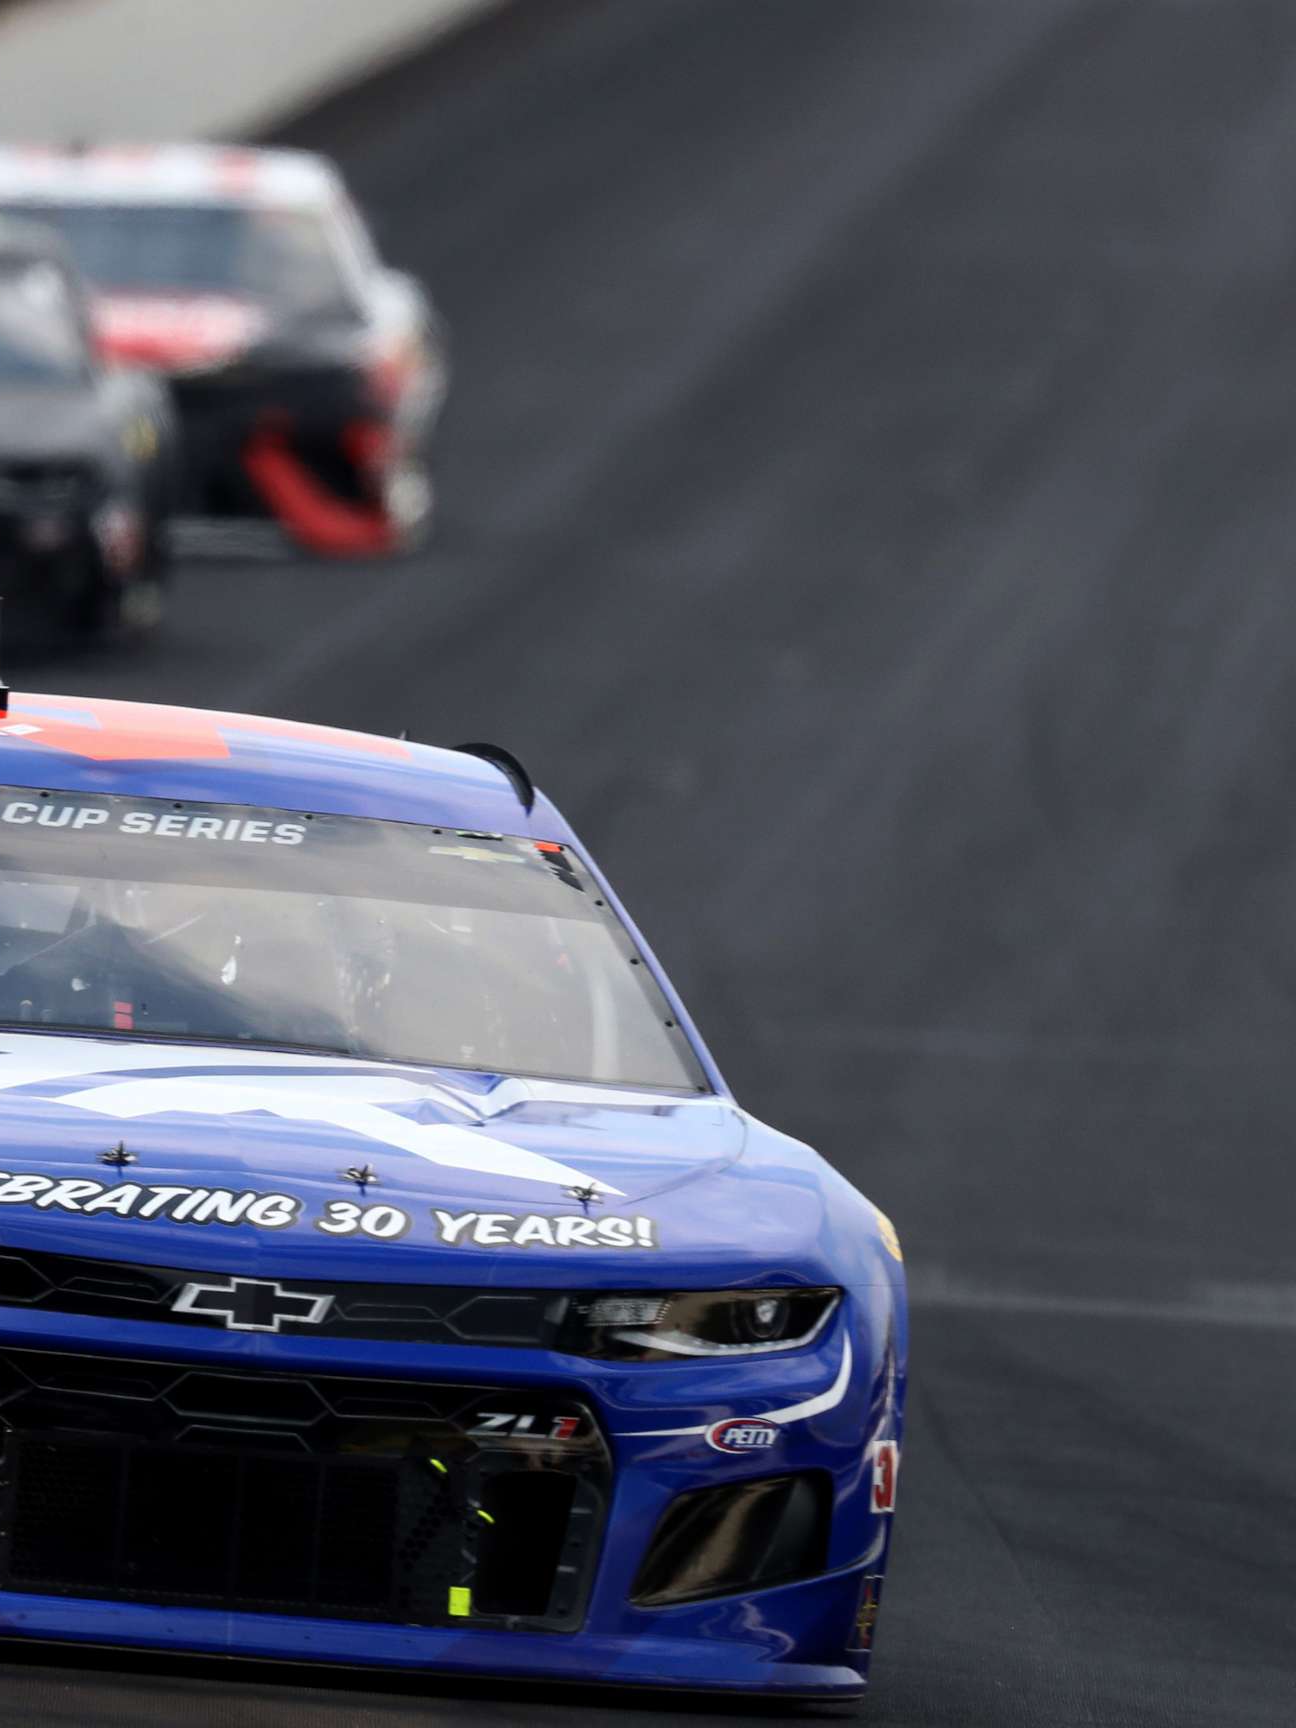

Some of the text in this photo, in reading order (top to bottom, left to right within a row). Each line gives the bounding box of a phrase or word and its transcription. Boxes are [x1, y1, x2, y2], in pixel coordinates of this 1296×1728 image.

[2, 801, 307, 846] CUP SERIES
[317, 1200, 406, 1239] 30
[433, 1208, 655, 1248] YEARS!
[464, 1412, 581, 1440] ZL1
[722, 1427, 781, 1445] PETTY
